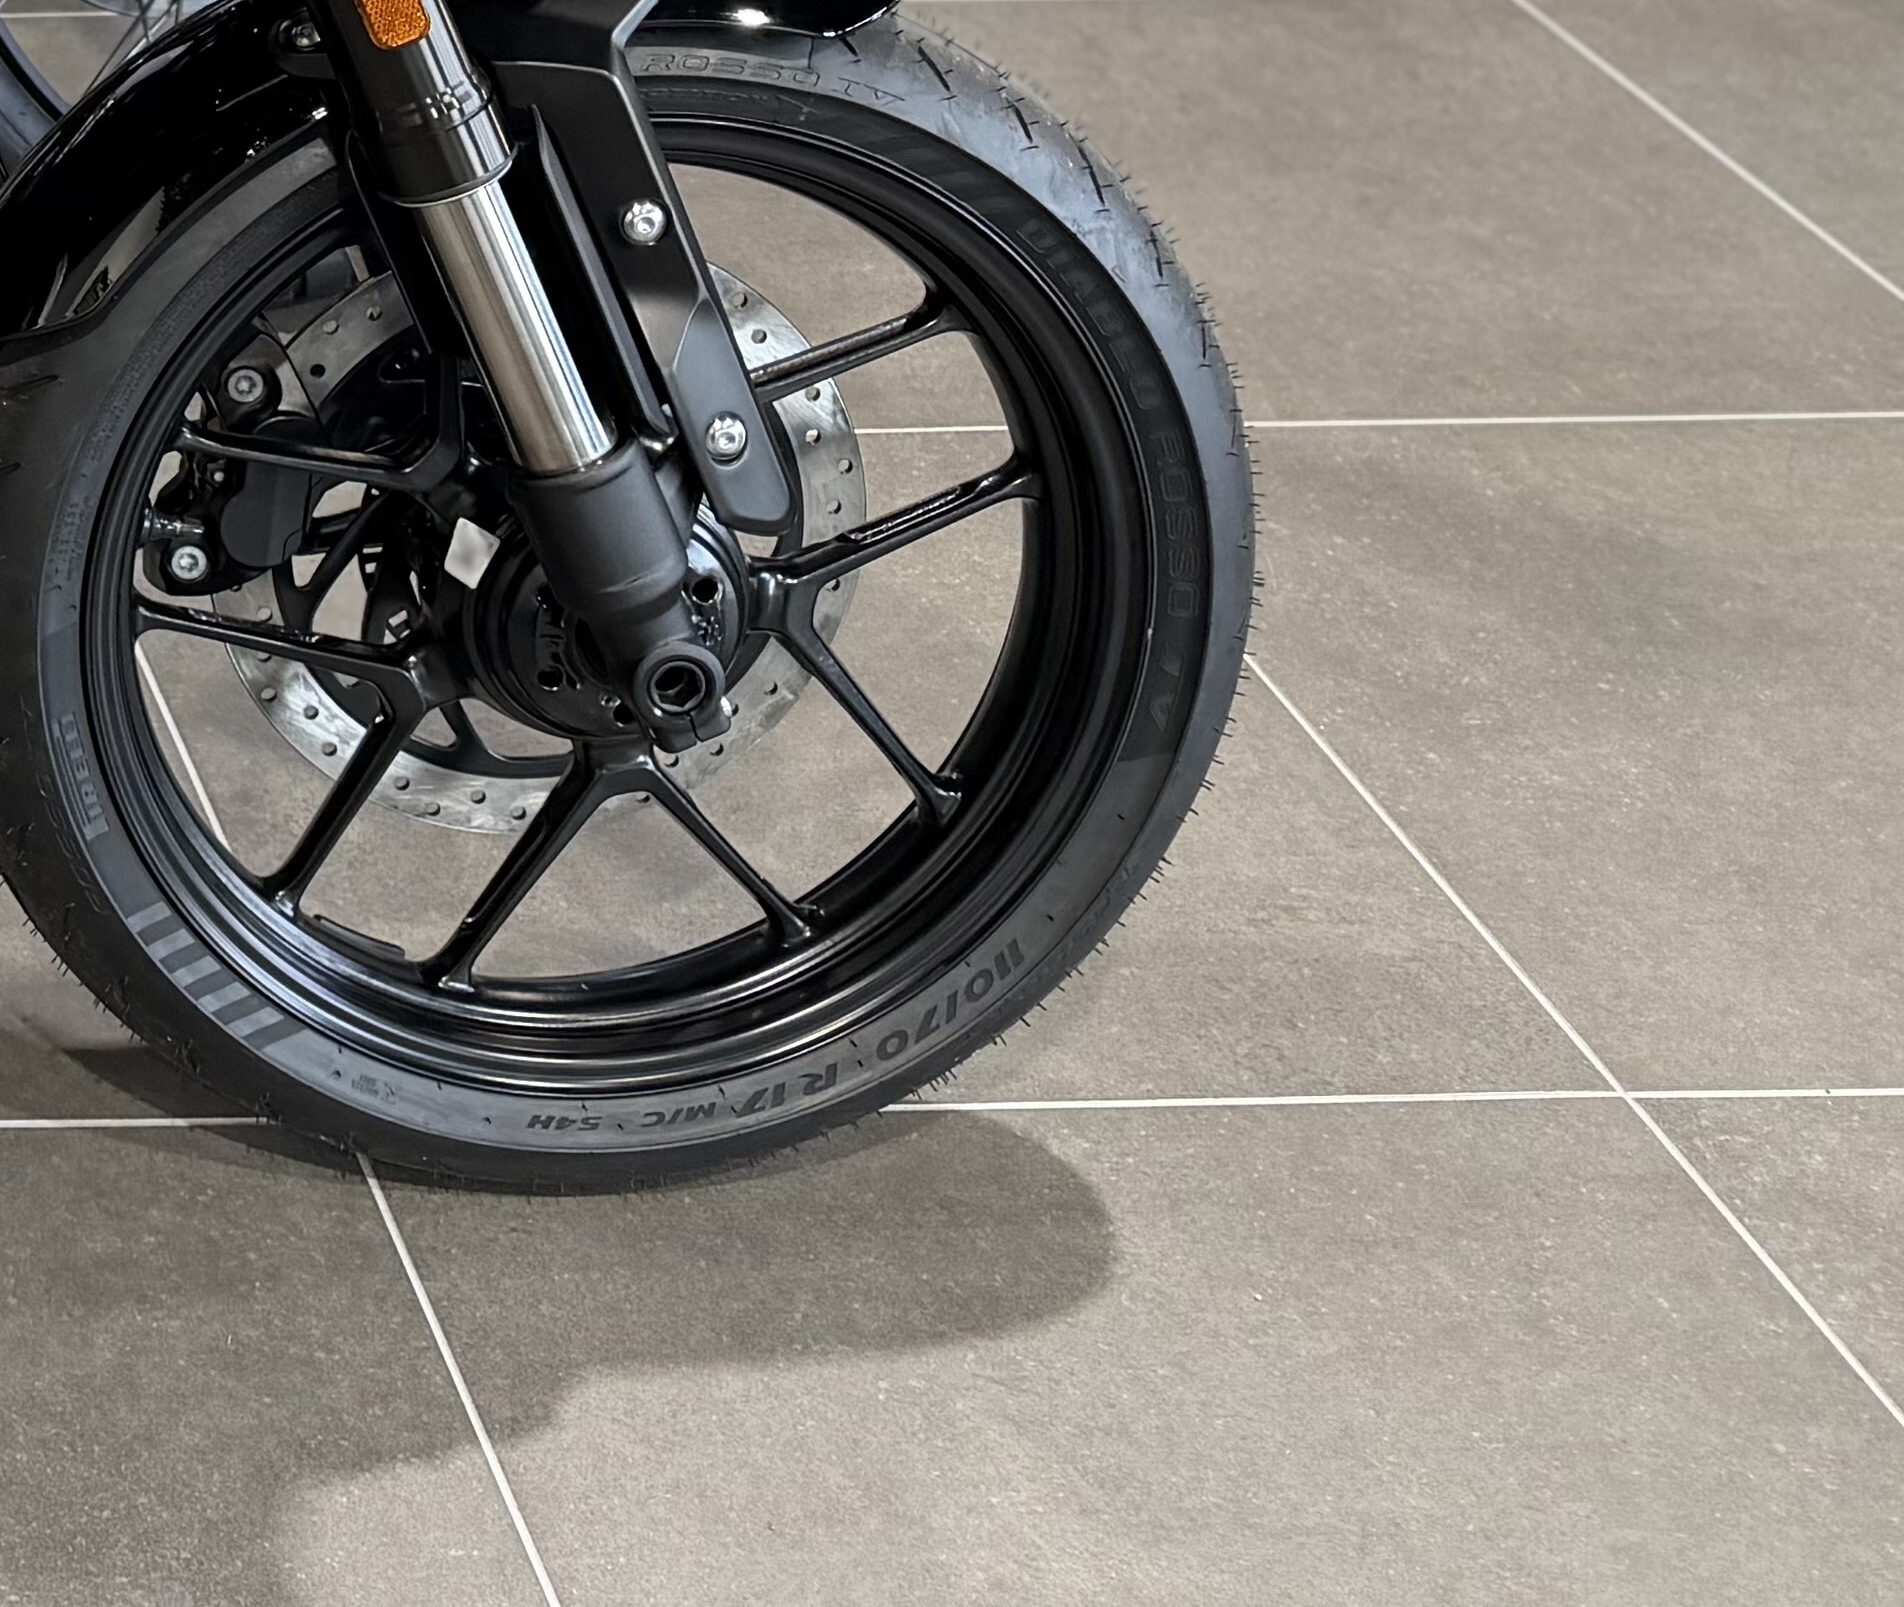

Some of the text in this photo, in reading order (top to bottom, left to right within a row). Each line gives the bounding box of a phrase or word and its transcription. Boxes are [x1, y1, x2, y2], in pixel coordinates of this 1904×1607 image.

[644, 52, 821, 89] ROSSO
[1016, 216, 1160, 412] DIABLO
[1151, 431, 1196, 618] ROSSO
[50, 712, 110, 840] PIRELLI
[875, 938, 1028, 1063] 110/70
[525, 1112, 603, 1132] 54H
[639, 1100, 716, 1129] M/C
